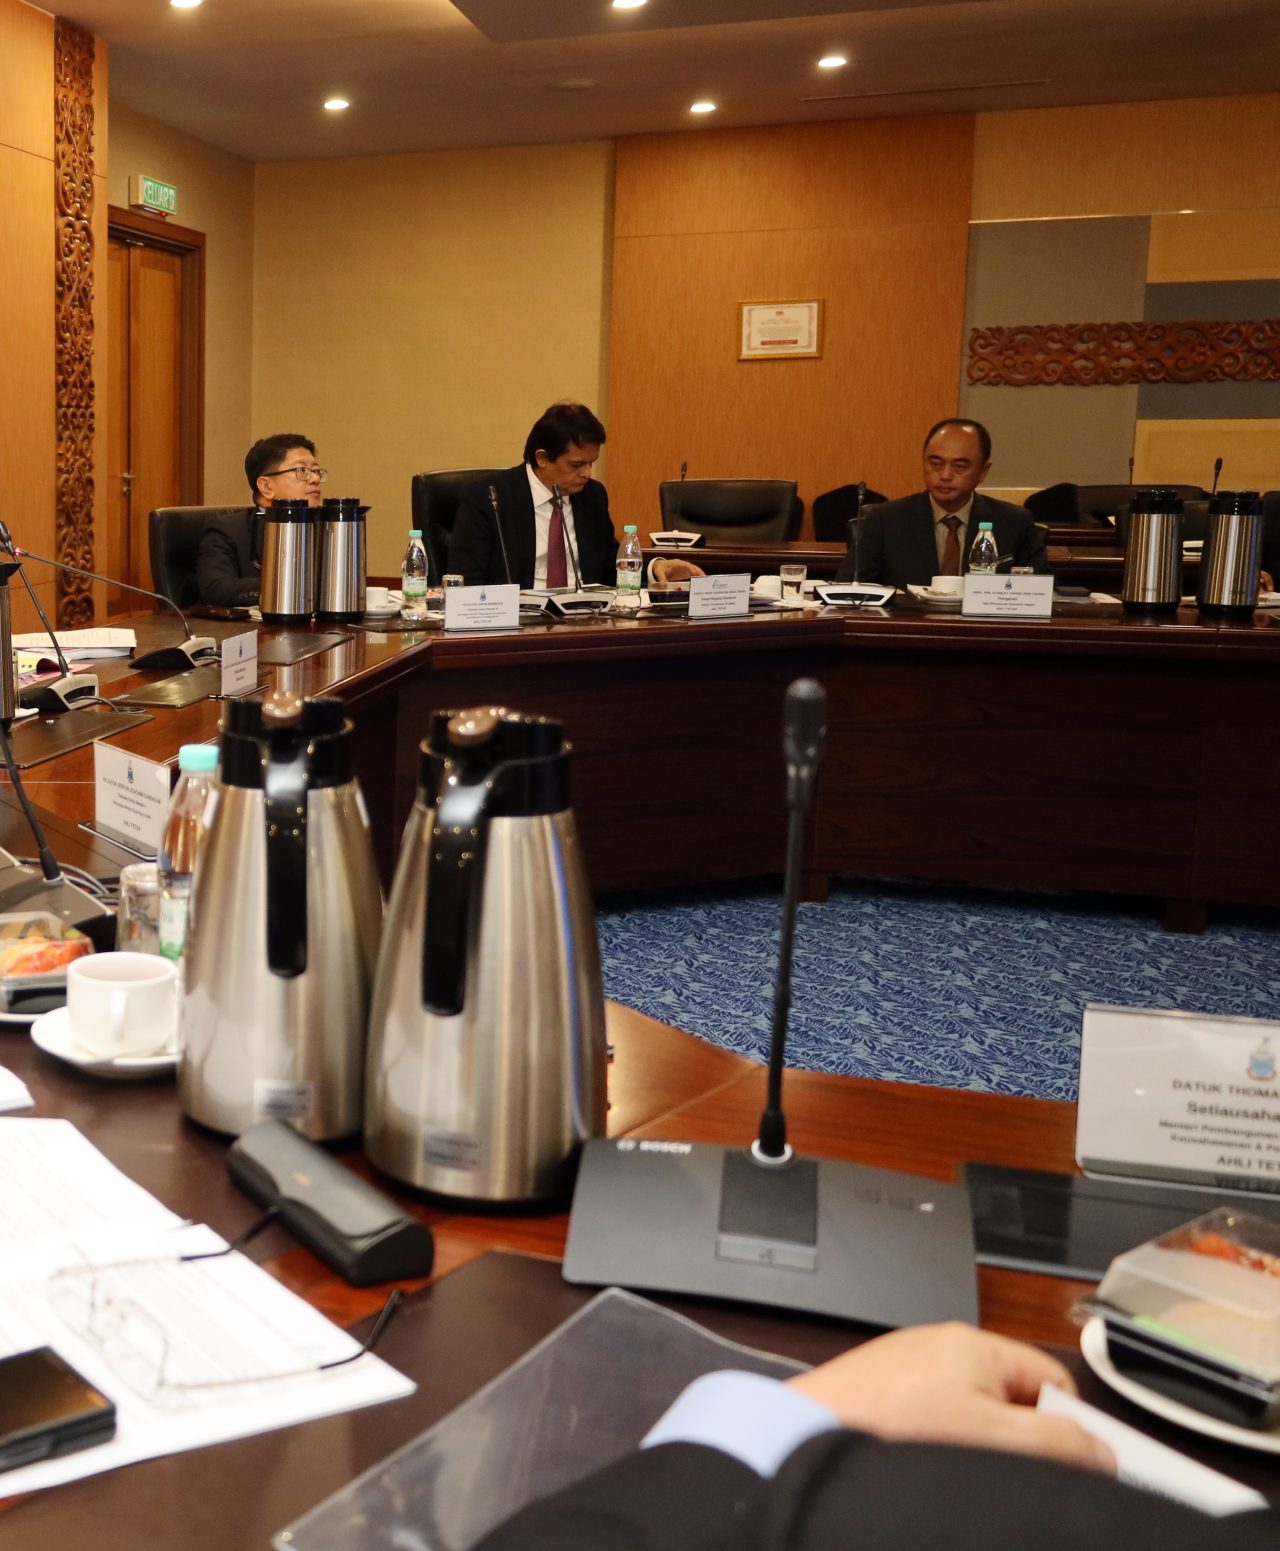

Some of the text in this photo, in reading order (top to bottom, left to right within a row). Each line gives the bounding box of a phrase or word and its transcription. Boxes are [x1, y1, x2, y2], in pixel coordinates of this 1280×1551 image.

[143, 179, 169, 208] KELUAR
[1172, 1079, 1221, 1094] DATUK
[639, 1140, 692, 1155] BOSCH
